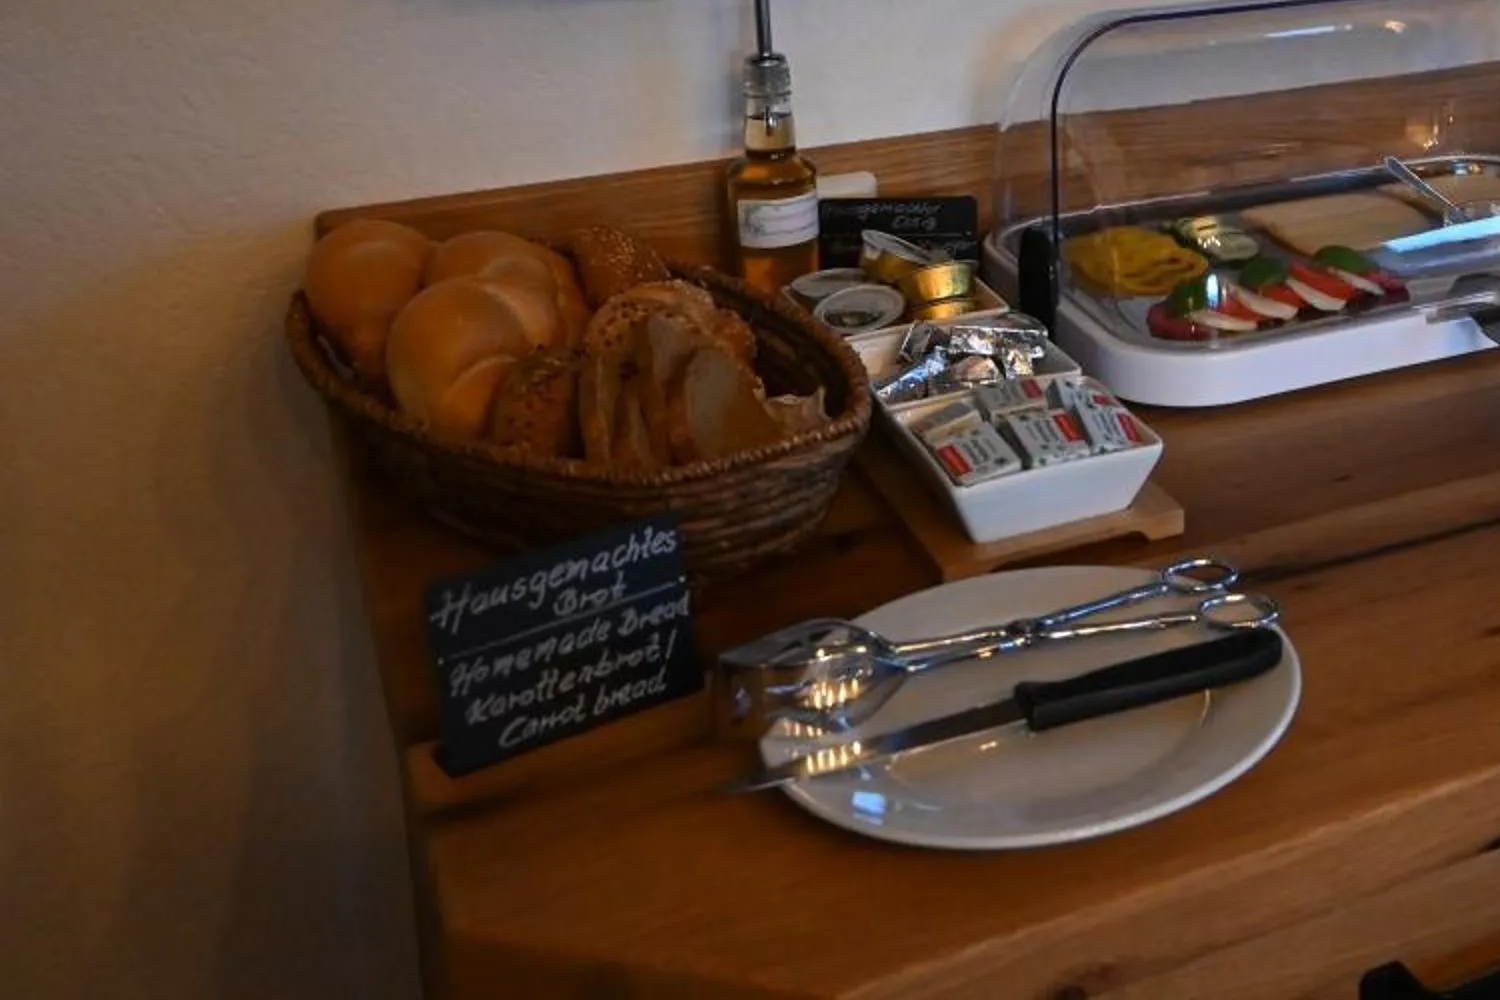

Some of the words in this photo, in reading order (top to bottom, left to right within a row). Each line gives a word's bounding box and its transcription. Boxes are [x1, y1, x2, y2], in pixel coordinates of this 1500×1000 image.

[428, 525, 678, 635] Hausgemachtes
[553, 569, 628, 617] Brot
[449, 617, 612, 698] Homemade
[617, 588, 691, 637] Bread
[498, 692, 588, 750] Carrot
[592, 664, 668, 717] bread
